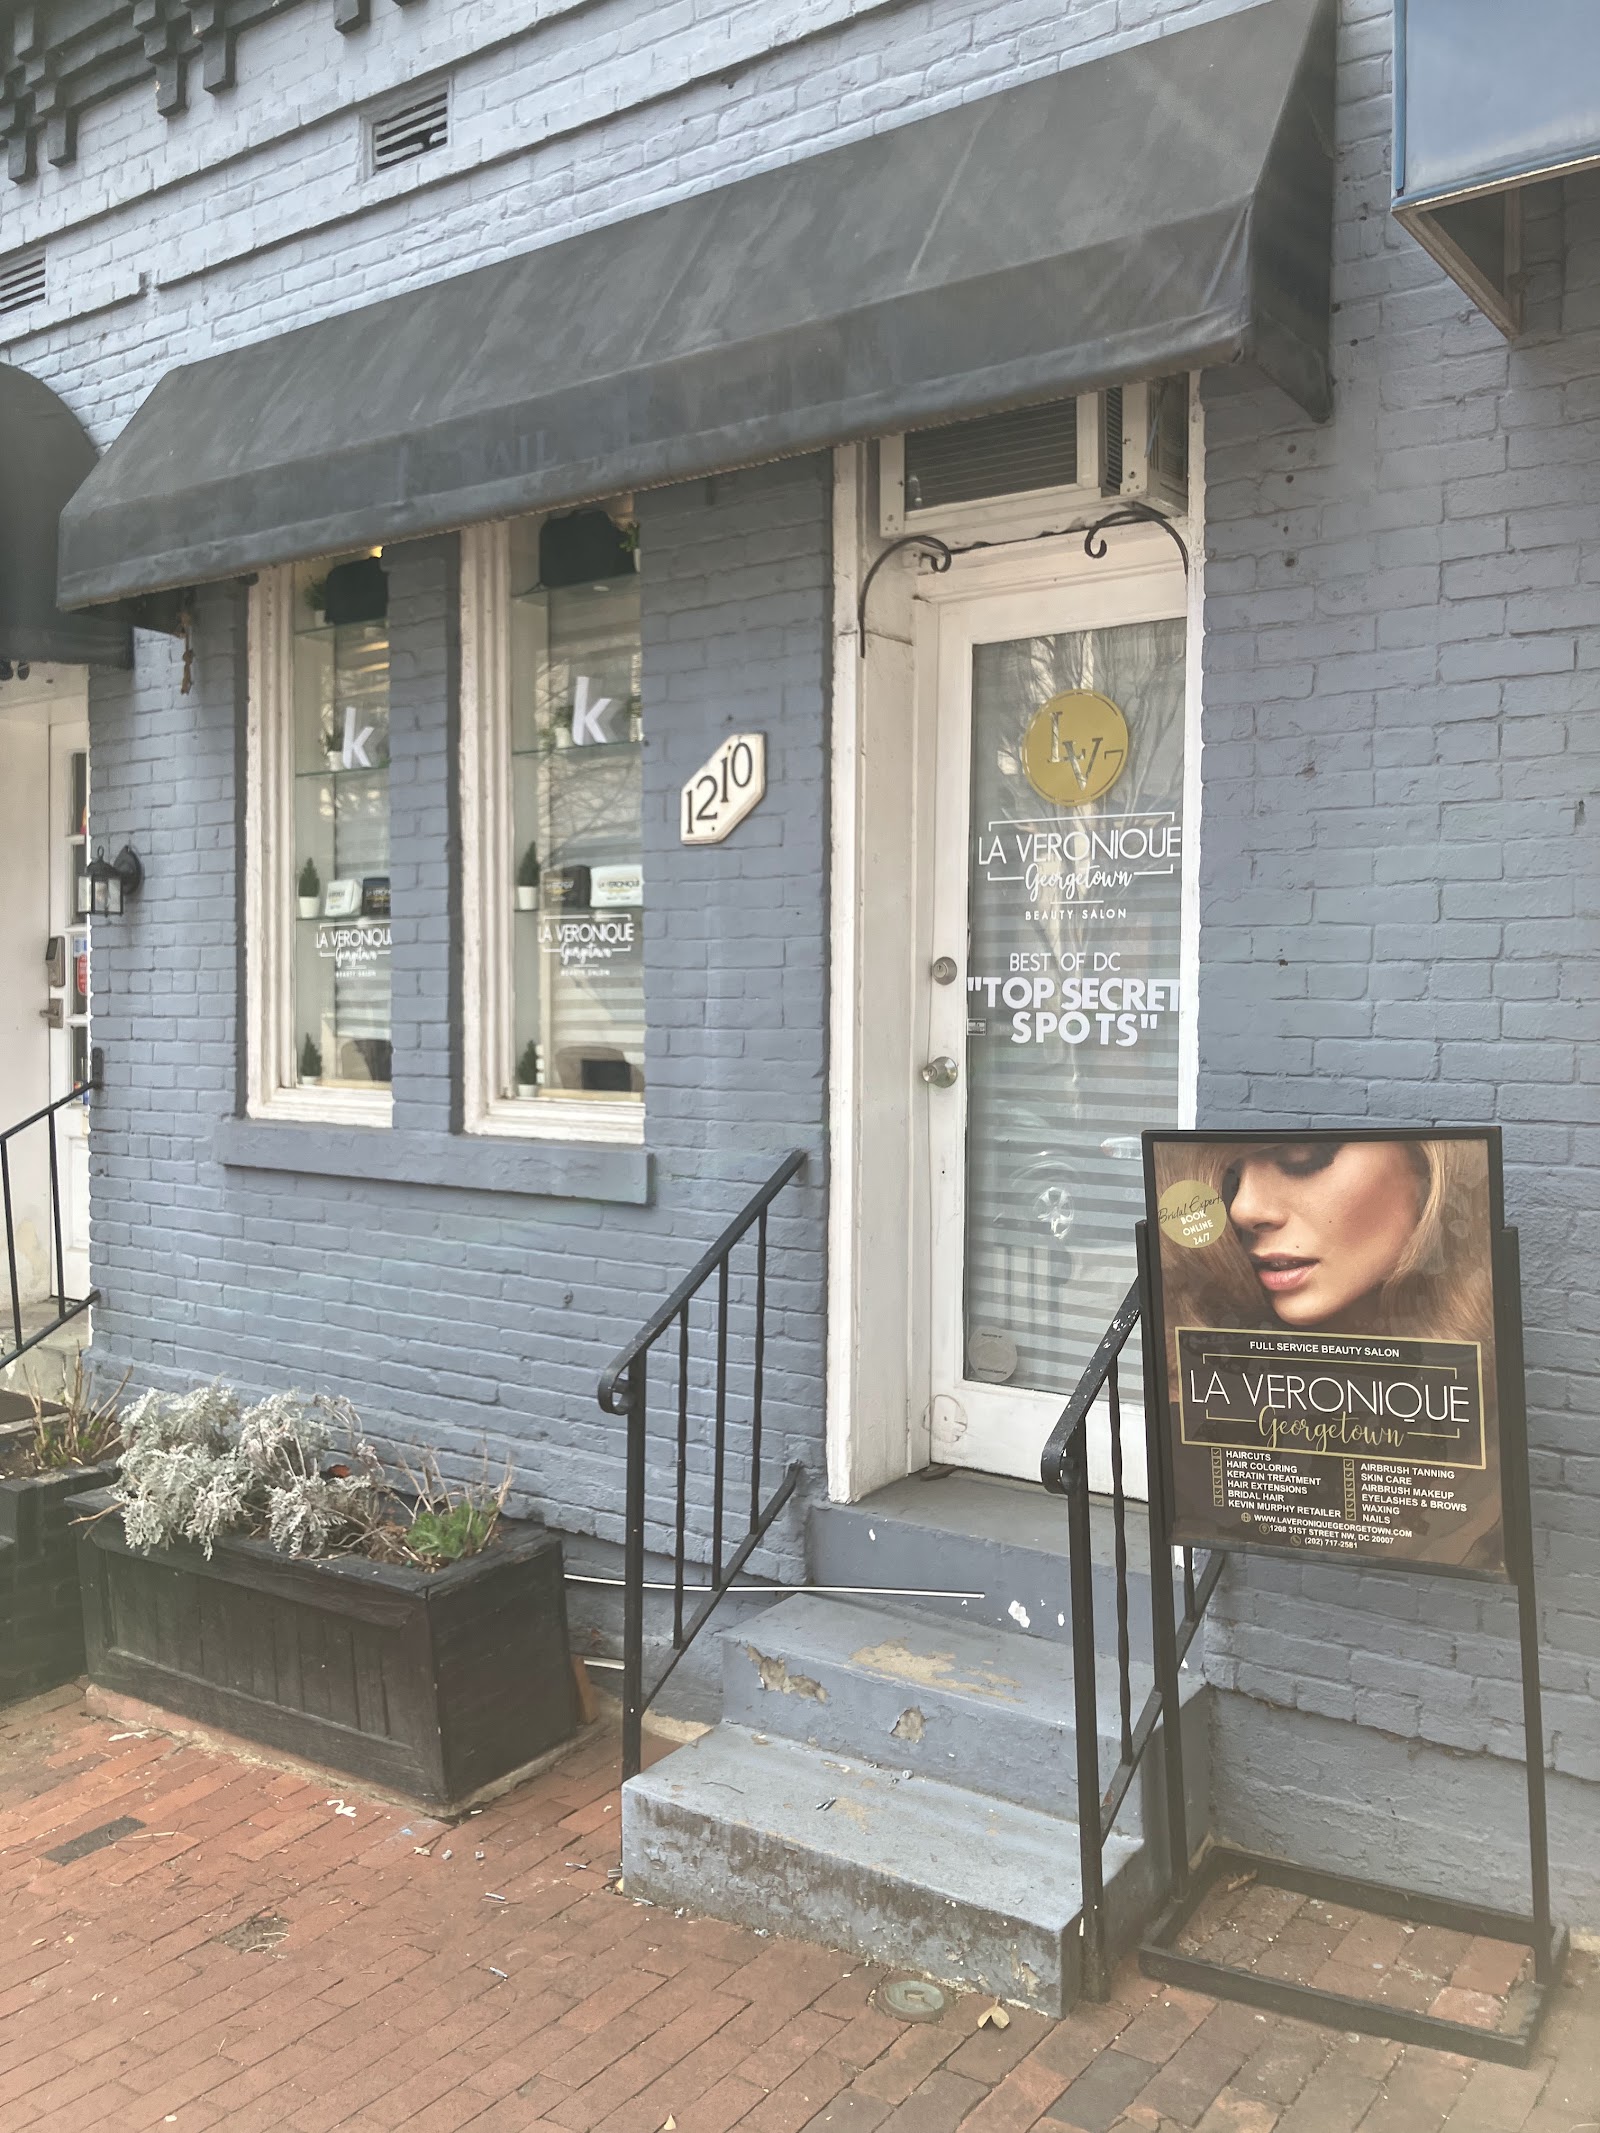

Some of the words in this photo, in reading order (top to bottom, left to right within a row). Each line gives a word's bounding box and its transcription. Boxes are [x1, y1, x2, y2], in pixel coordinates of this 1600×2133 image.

[571, 676, 612, 746] k
[342, 706, 375, 769] k
[686, 743, 753, 834] 1210
[978, 835, 1007, 865] LA
[1025, 862, 1133, 902] Georgetown
[1025, 909, 1074, 921] BEAUTY
[1081, 908, 1127, 920] SALON
[316, 931, 329, 949] LA
[537, 925, 553, 943] LA
[1009, 952, 1052, 972] BEST
[1060, 952, 1086, 971] OF
[1093, 952, 1121, 972] DC
[967, 977, 1055, 1009] "TOP
[1061, 977, 1180, 1012] SECRET
[1011, 1010, 1158, 1047] SPOTS"
[1158, 1203, 1187, 1224] Bridal
[1180, 1209, 1207, 1225] BOOK
[1182, 1219, 1214, 1236] ONLINE
[1193, 1232, 1210, 1245] 24/7
[1249, 1341, 1275, 1351] FULL
[1276, 1342, 1319, 1353] SERVICE
[1321, 1345, 1362, 1356] BEAUTY
[1364, 1347, 1400, 1358] SALON
[1190, 1369, 1231, 1405] LA
[1242, 1372, 1470, 1423] VERONIQUE
[1258, 1404, 1405, 1452] Georgetown
[1226, 1450, 1271, 1462] HAIRCUTS
[1226, 1460, 1248, 1470] HAIR
[1250, 1462, 1298, 1474] COLORING
[1360, 1463, 1410, 1475] AIRBRUSH
[1412, 1467, 1455, 1479] TANNING
[1226, 1470, 1265, 1481] KERATIN
[1267, 1473, 1321, 1486] TREATMENT
[1360, 1473, 1383, 1483] SKIN
[1385, 1475, 1412, 1485] CARE
[1227, 1480, 1249, 1489] HAIR
[1251, 1482, 1308, 1494] EXTENSIONS
[1361, 1483, 1411, 1496] AIRBRUSH
[1413, 1488, 1455, 1500] MAKEUP
[1227, 1490, 1261, 1500] BRIDAL
[1263, 1493, 1285, 1502] HAIR
[1361, 1494, 1419, 1507] EYELASHES
[1420, 1500, 1428, 1508] &
[1430, 1500, 1468, 1512] BROWS
[1228, 1499, 1255, 1509] KEVIN
[1257, 1502, 1295, 1513] MURPHY
[1297, 1506, 1341, 1518] RETAILER
[1361, 1503, 1400, 1515] WAXING
[1362, 1514, 1391, 1524] NAILS
[1269, 1525, 1287, 1533] 1208
[1288, 1527, 1307, 1535] 31ST
[1308, 1528, 1340, 1538] STREET
[1358, 1534, 1370, 1542] DC
[1372, 1535, 1394, 1545] 20007
[1304, 1537, 1323, 1546] (202)
